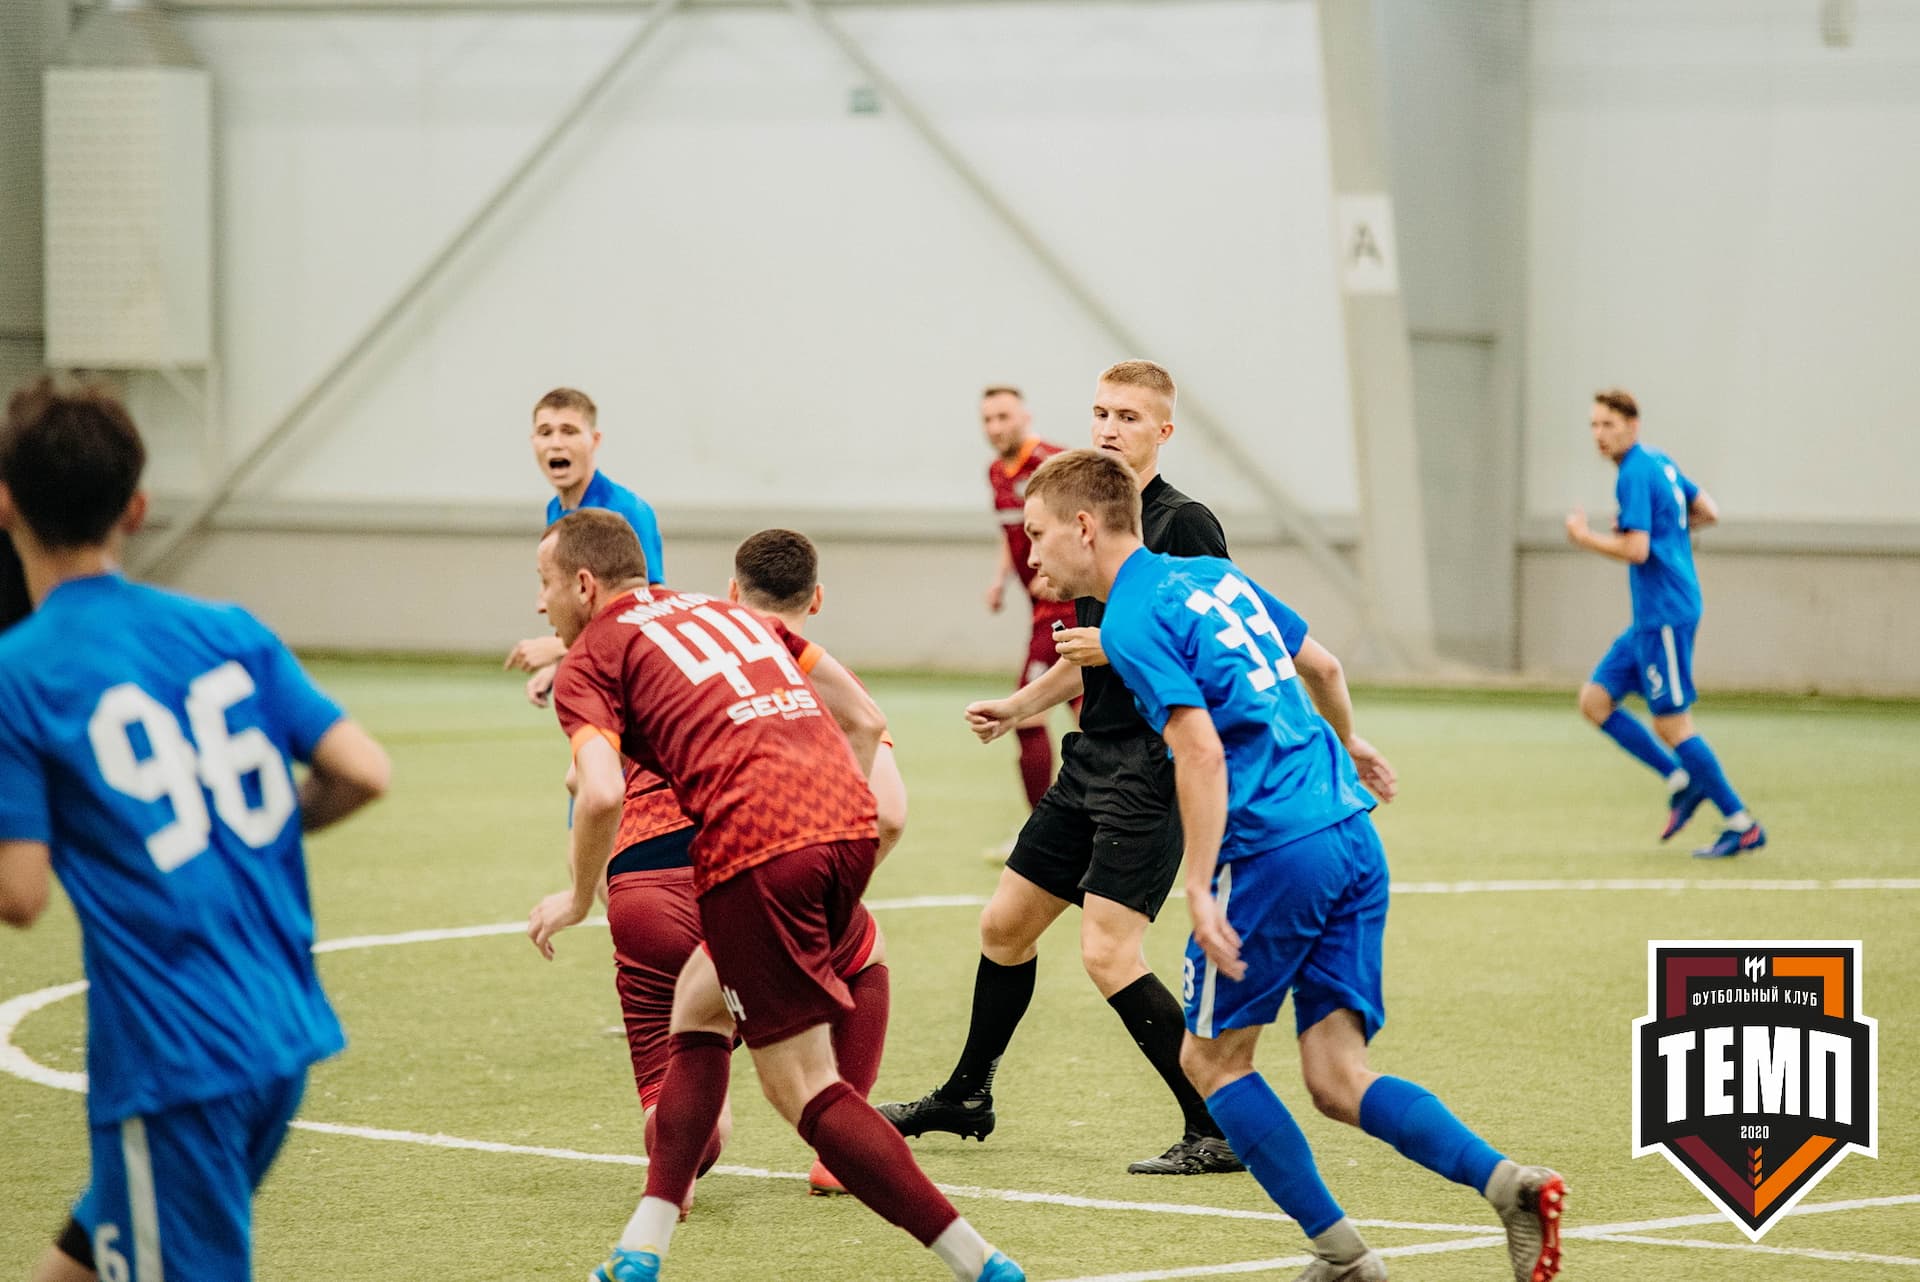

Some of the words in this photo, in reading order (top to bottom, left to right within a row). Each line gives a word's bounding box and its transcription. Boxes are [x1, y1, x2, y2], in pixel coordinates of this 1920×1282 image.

[640, 606, 804, 697] 44
[1185, 573, 1297, 692] 33
[727, 688, 817, 725] SEUS
[88, 660, 296, 873] 96
